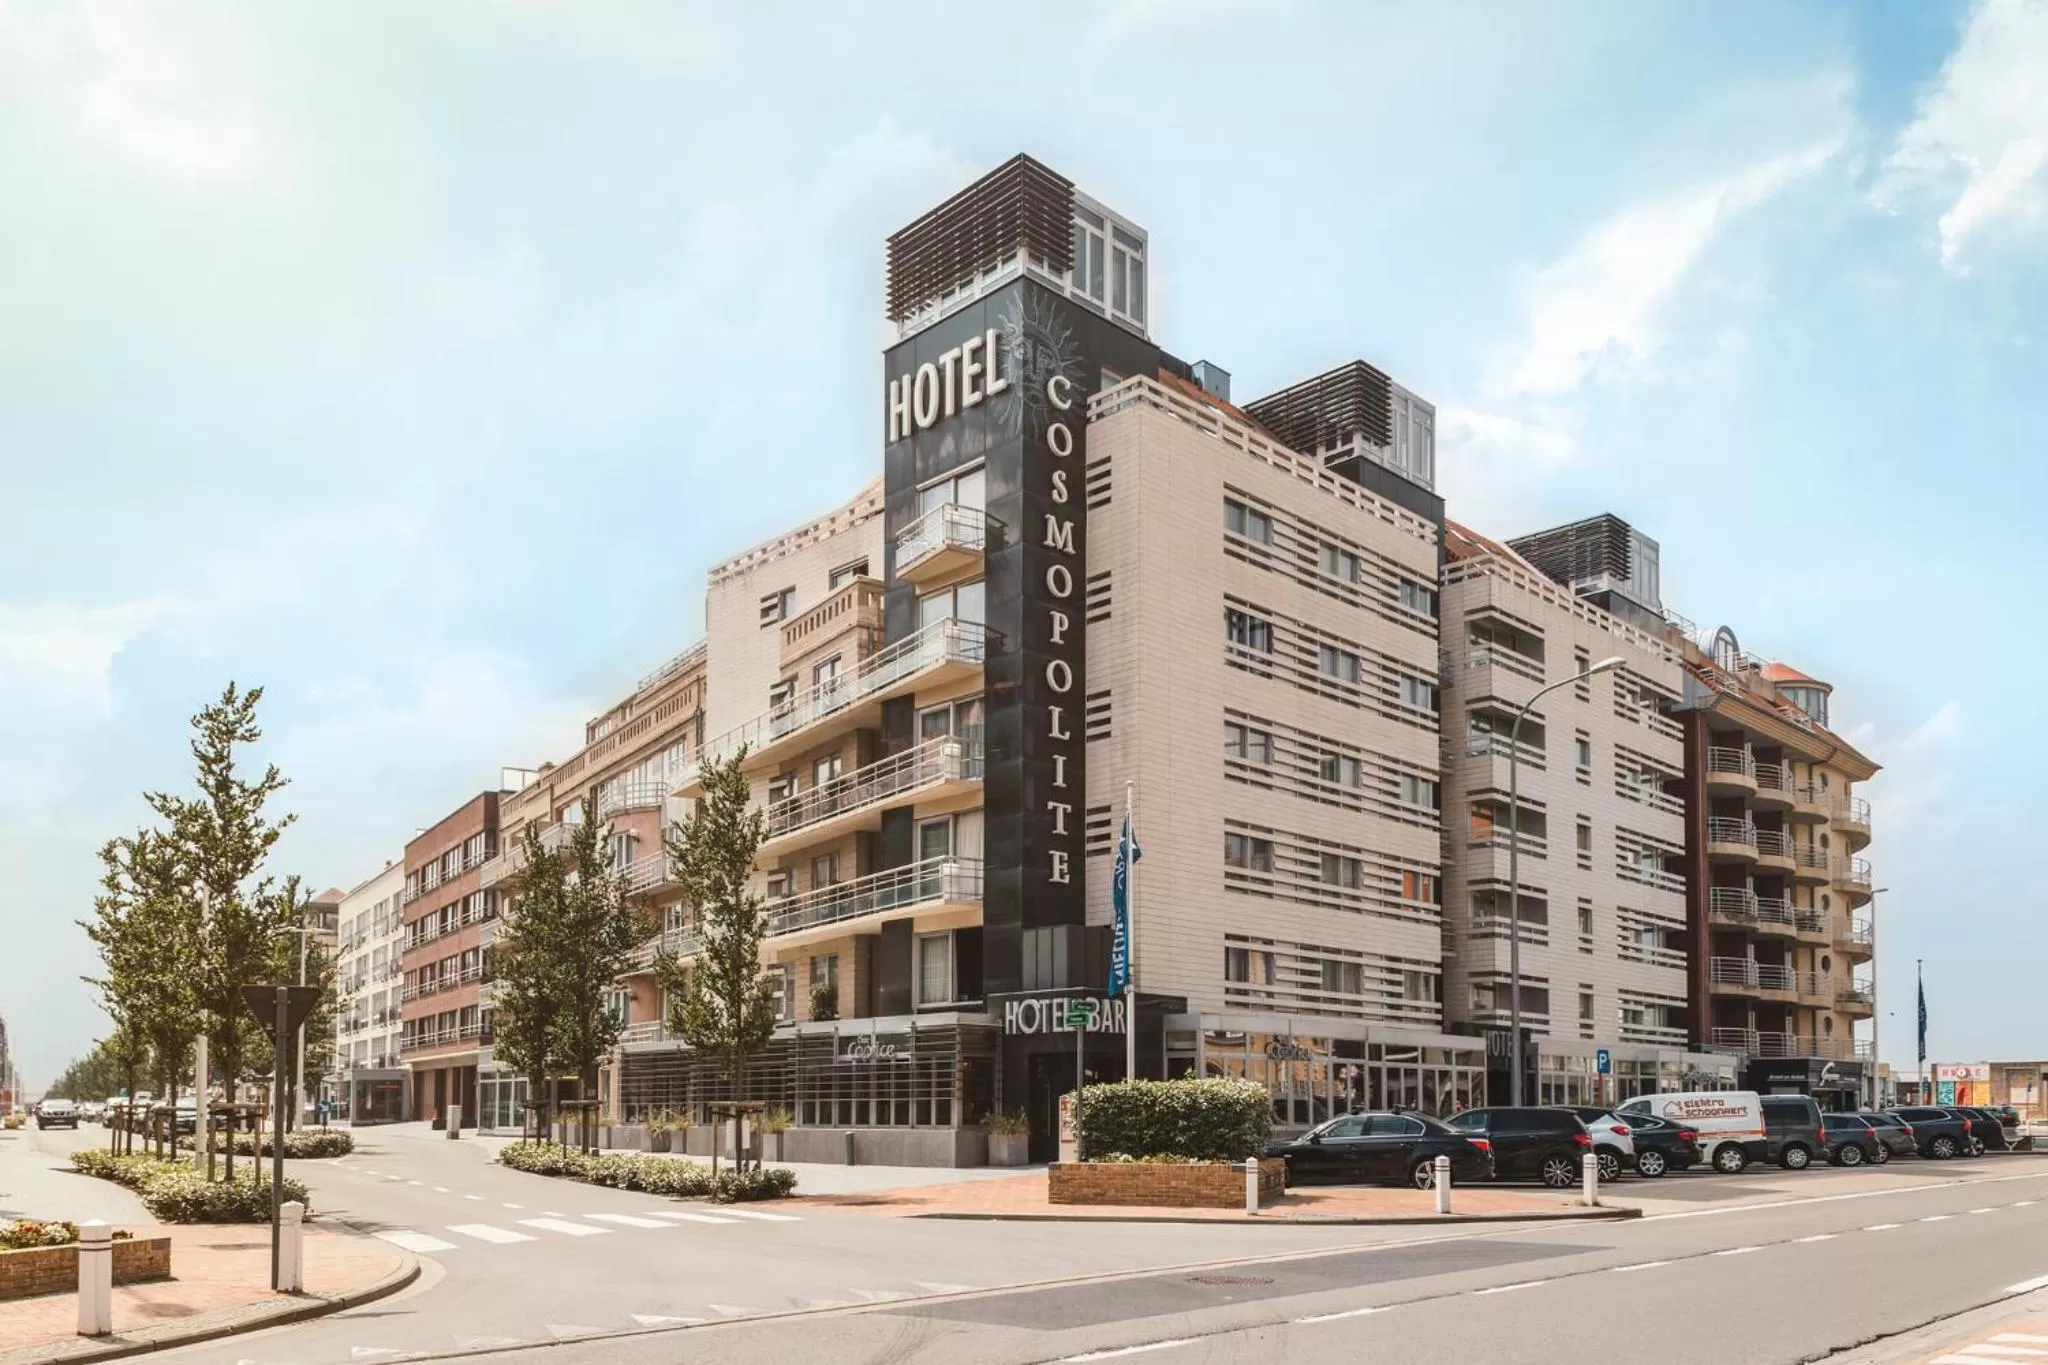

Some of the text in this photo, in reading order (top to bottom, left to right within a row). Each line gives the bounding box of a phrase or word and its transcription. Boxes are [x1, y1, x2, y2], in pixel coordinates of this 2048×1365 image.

[889, 328, 1007, 442] HOTEL
[1044, 374, 1077, 885] COSMOPOLITE
[1005, 998, 1126, 1035] HOTEL BAR
[1599, 1053, 1608, 1069] P
